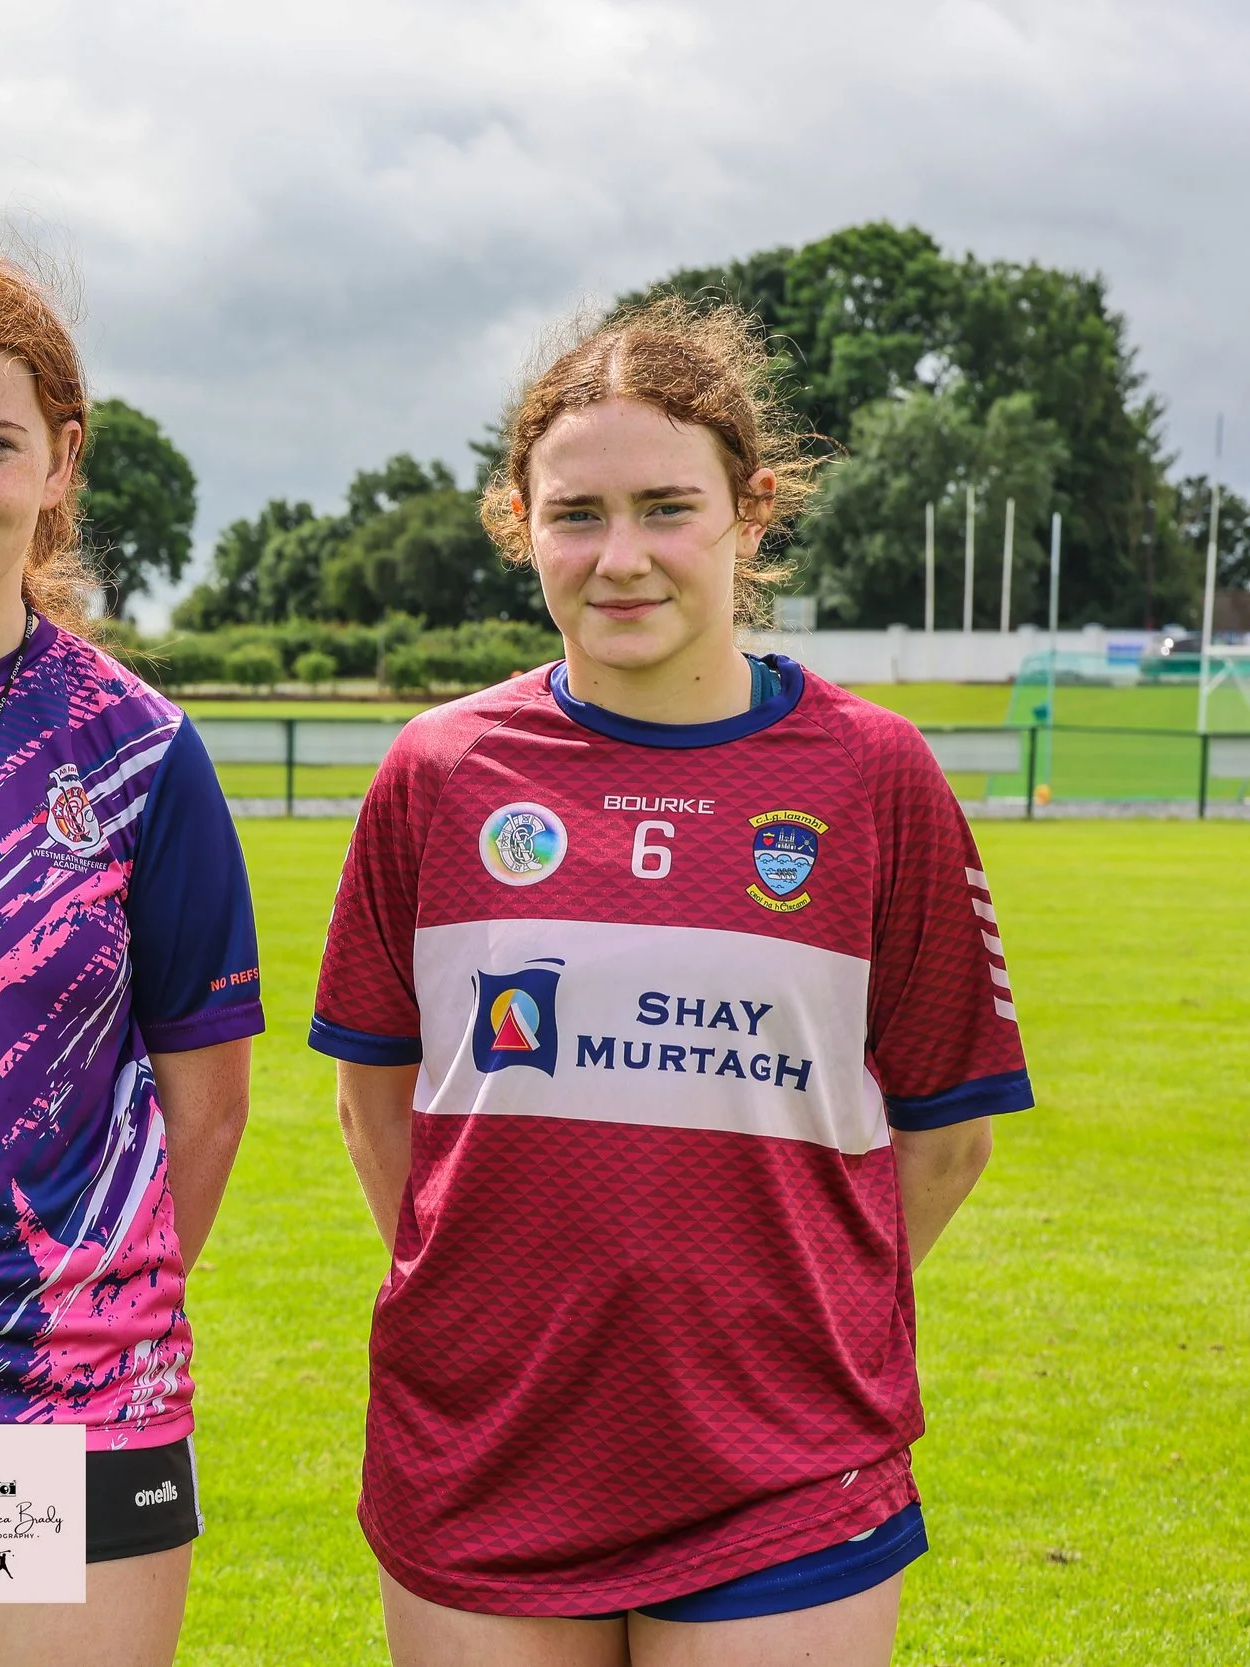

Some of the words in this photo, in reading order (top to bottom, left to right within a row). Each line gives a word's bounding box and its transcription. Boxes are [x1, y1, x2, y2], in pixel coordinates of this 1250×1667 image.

[603, 795, 716, 815] BOURKE
[32, 848, 80, 864] WESTMEATH
[79, 858, 108, 871] REFEREE
[631, 820, 675, 880] 6
[53, 860, 89, 874] ACADEMY
[210, 976, 227, 992] NO
[230, 967, 259, 986] REFS
[636, 991, 774, 1036] SHAY
[575, 1034, 813, 1093] MURTAGH
